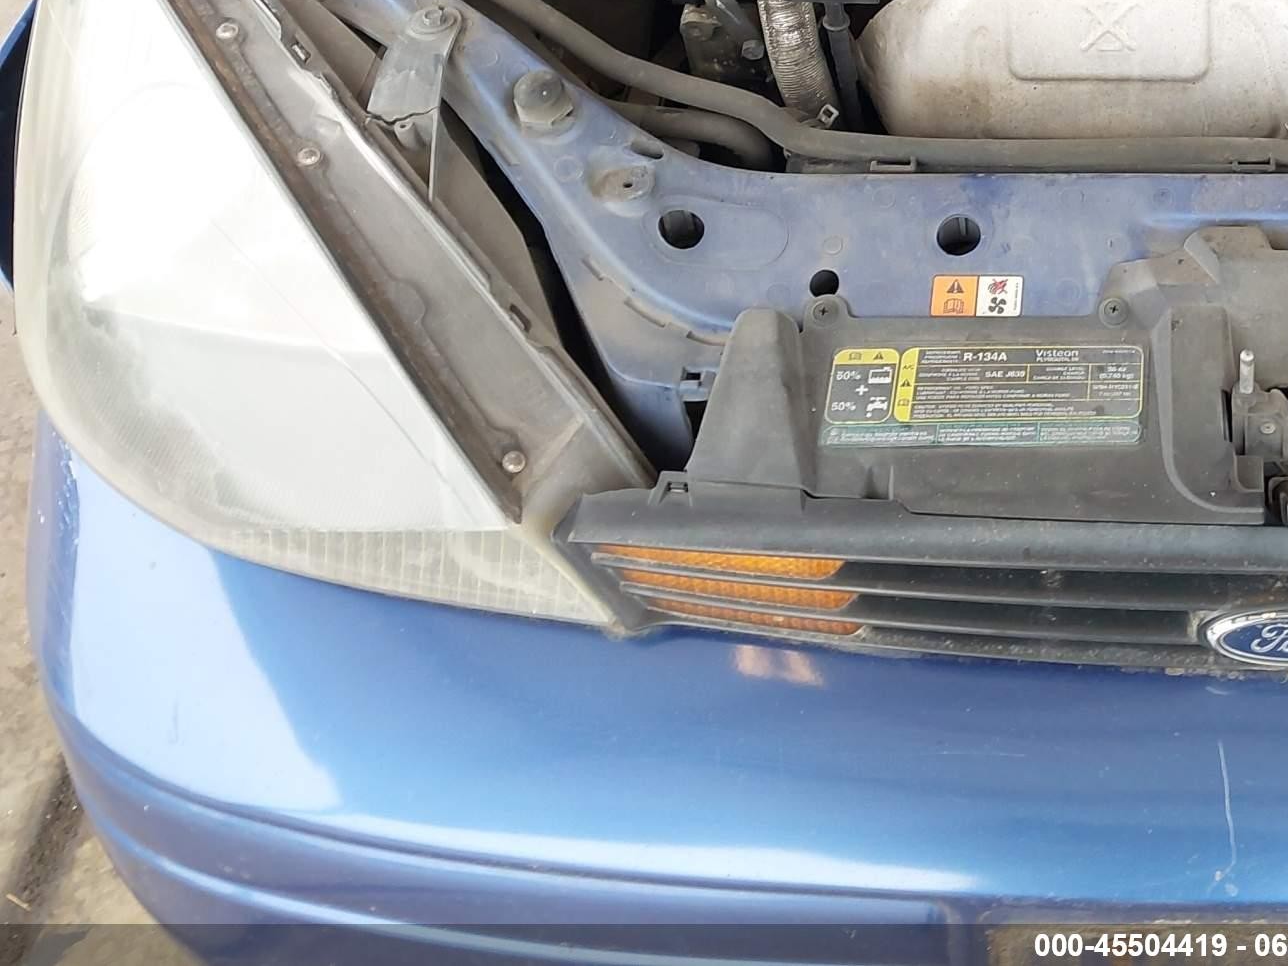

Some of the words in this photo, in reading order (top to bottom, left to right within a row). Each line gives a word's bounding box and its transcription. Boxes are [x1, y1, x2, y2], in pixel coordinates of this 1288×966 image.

[962, 351, 1008, 362] R-134A
[1035, 349, 1080, 357] Visteon
[835, 370, 862, 381] 50%
[984, 370, 1004, 378] SAE
[831, 400, 857, 411] 50%
